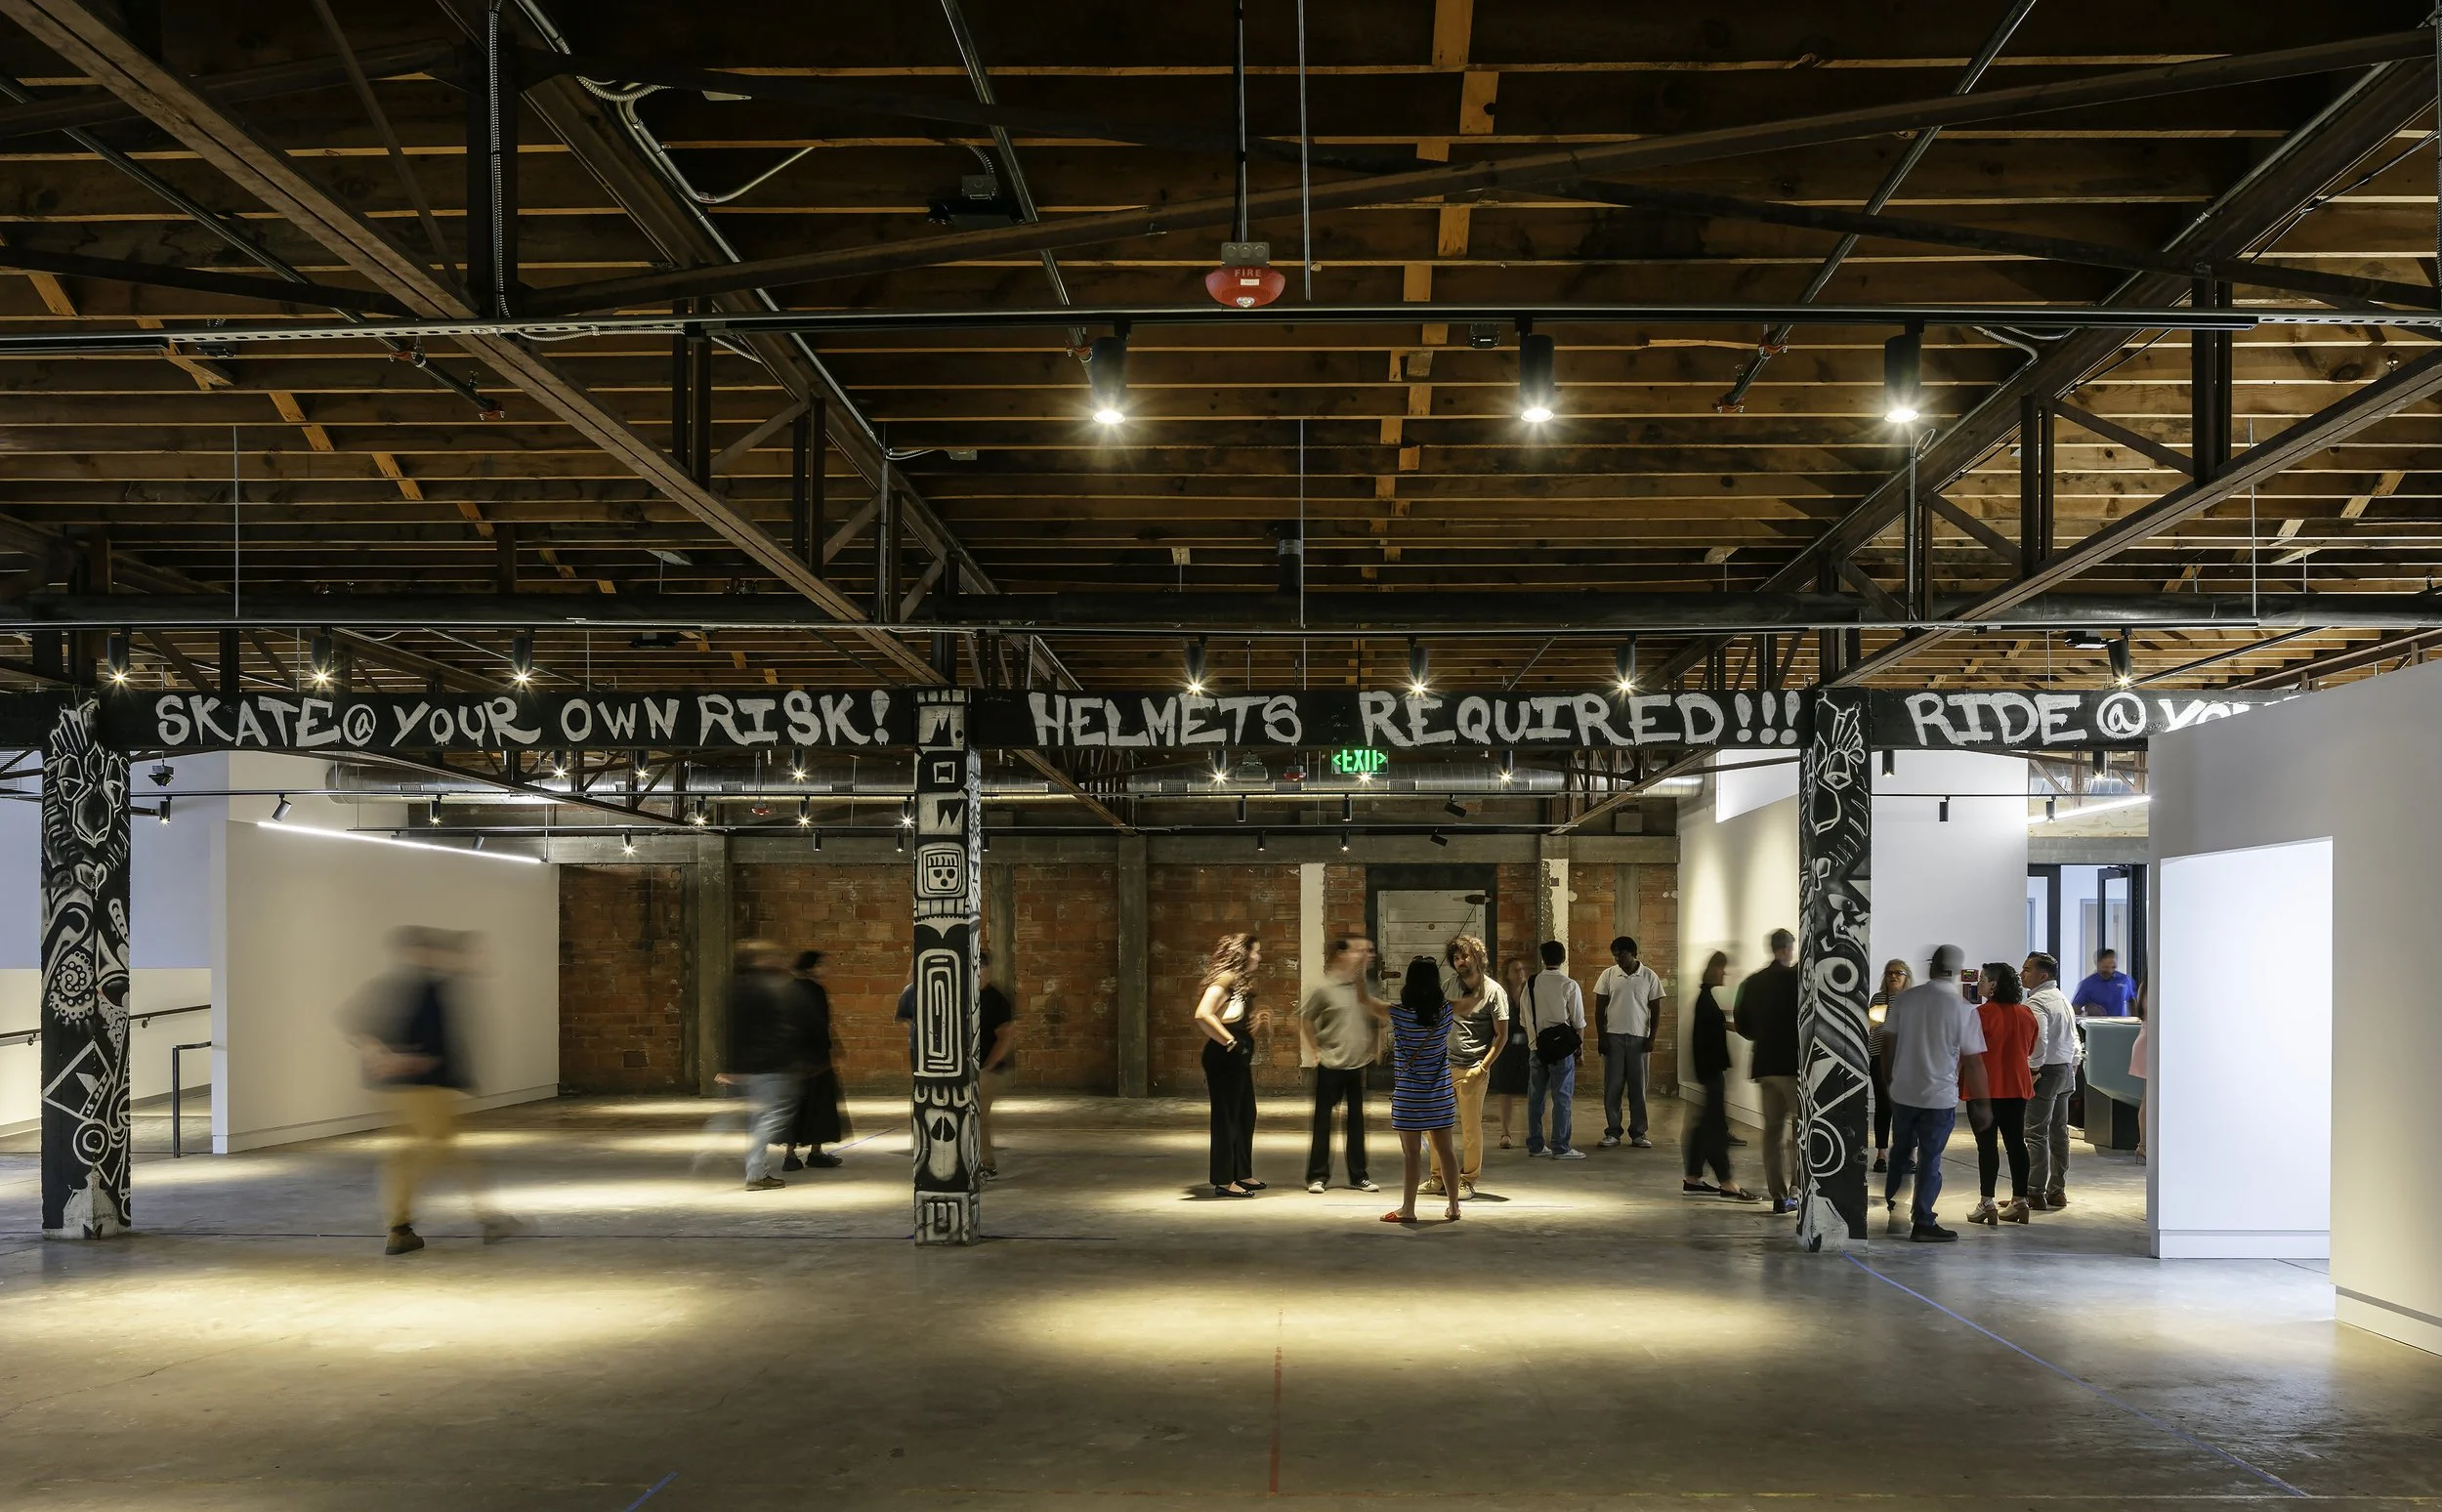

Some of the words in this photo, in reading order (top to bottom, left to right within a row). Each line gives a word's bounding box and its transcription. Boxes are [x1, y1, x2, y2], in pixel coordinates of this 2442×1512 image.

[1235, 269, 1262, 277] FIRE
[392, 697, 541, 746] YOUR
[561, 697, 680, 741] OWN
[698, 691, 890, 745] RISK!
[1029, 693, 1303, 746] HELMETS
[1906, 693, 2086, 745] RIDE
[2095, 692, 2147, 739] @
